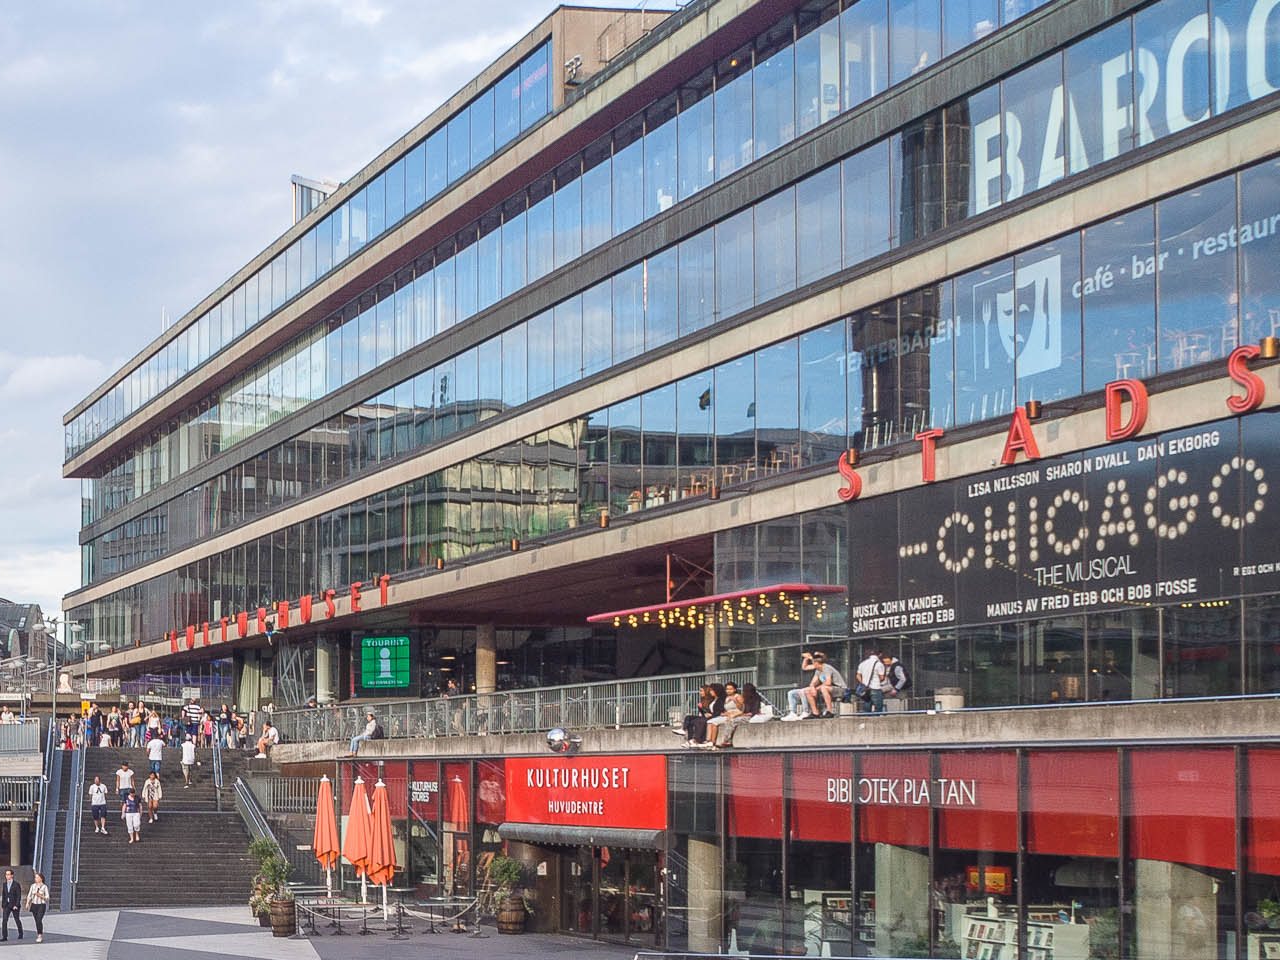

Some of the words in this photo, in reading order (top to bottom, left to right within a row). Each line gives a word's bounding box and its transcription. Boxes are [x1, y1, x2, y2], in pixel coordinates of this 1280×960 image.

[1071, 264, 1114, 298] café
[1132, 251, 1169, 279] bar
[1192, 214, 1280, 260] restaur
[837, 345, 1266, 501] STADS
[968, 480, 991, 497] LISA
[994, 471, 1039, 493] NILSSON
[1046, 459, 1092, 481] SHARON
[1095, 451, 1130, 471] DYALL
[1137, 442, 1165, 462] DAN
[1168, 431, 1220, 455] EKBORG
[1034, 564, 1063, 587] THE
[1065, 555, 1136, 582] MUSICAL
[170, 573, 391, 653] KULTURHUSET
[852, 603, 880, 619] MUSIK
[881, 600, 906, 614] JOHN
[908, 594, 944, 611] KANDER
[986, 601, 1023, 618] MANUS
[1025, 599, 1039, 613] AV
[1041, 595, 1070, 611] FRED
[1073, 591, 1098, 607] EBB
[1101, 588, 1124, 604] OCH
[1128, 584, 1151, 600] BOB
[1155, 578, 1197, 598] FOSSE
[852, 615, 908, 633] SÅNGTEXTER
[910, 611, 934, 626] FRED
[936, 608, 955, 623] EBB
[527, 767, 629, 789] KULTURHUSET
[903, 779, 976, 805] PLATAN
[548, 799, 604, 815] HUVUDENTRÉ
